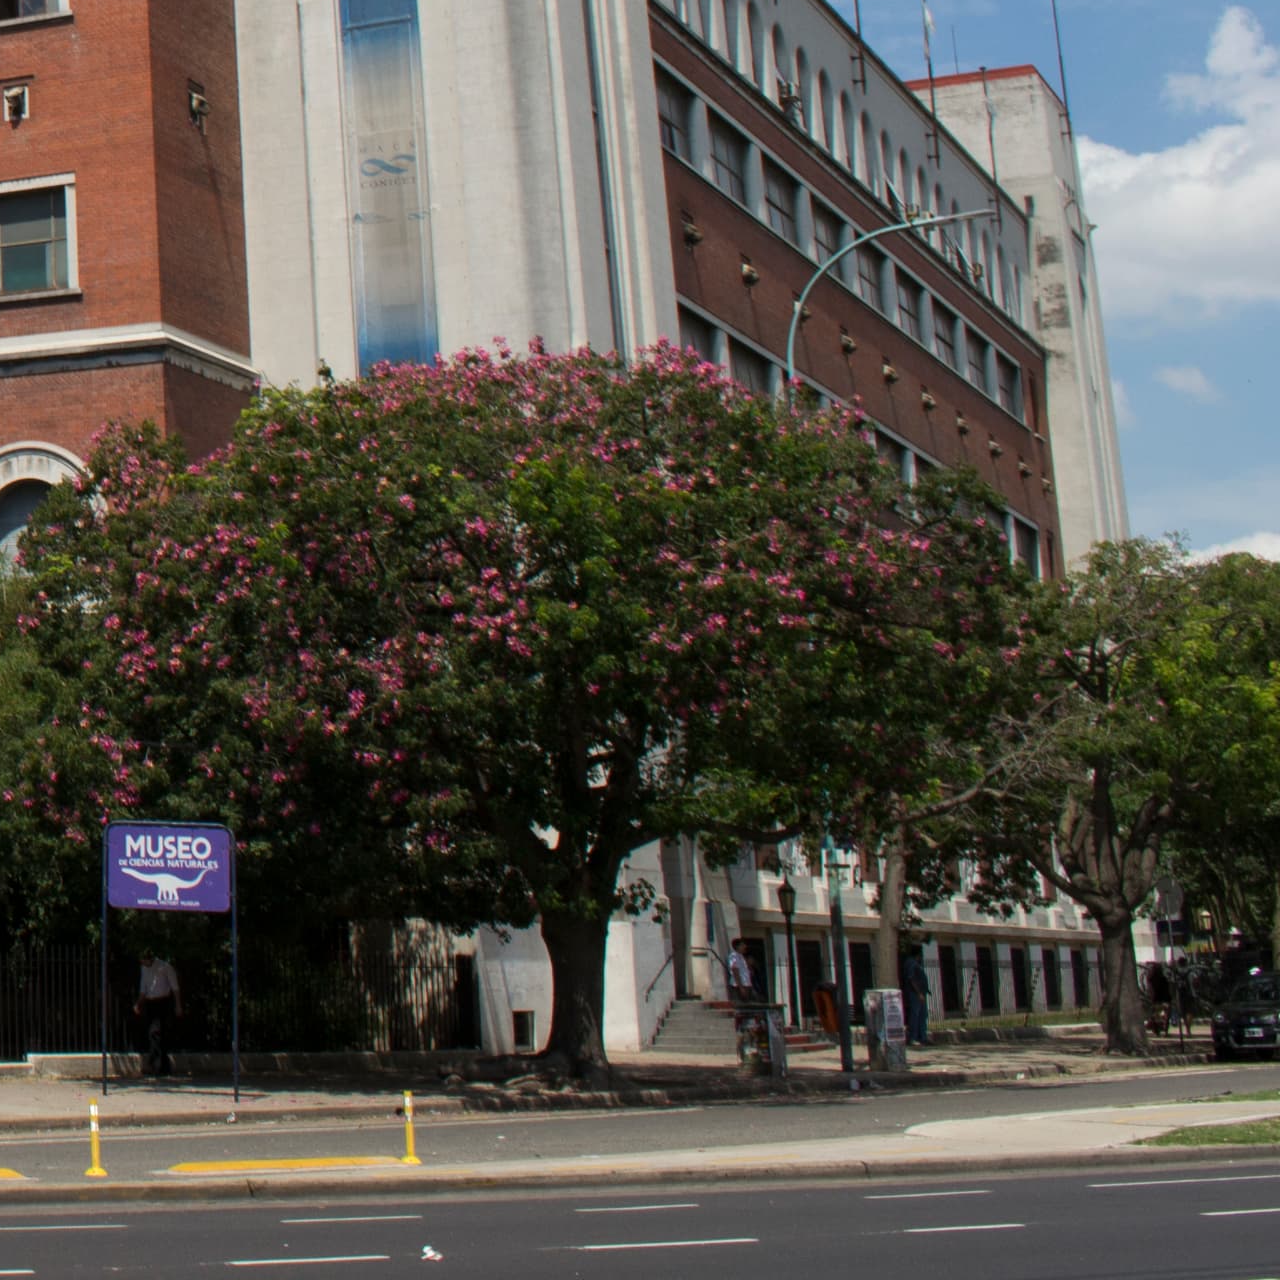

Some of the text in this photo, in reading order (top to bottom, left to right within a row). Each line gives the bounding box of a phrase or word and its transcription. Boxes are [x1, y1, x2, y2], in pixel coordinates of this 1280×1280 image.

[125, 833, 212, 860] MUSEO
[128, 858, 165, 867] CIENCIAS
[167, 859, 219, 870] NATURALES
